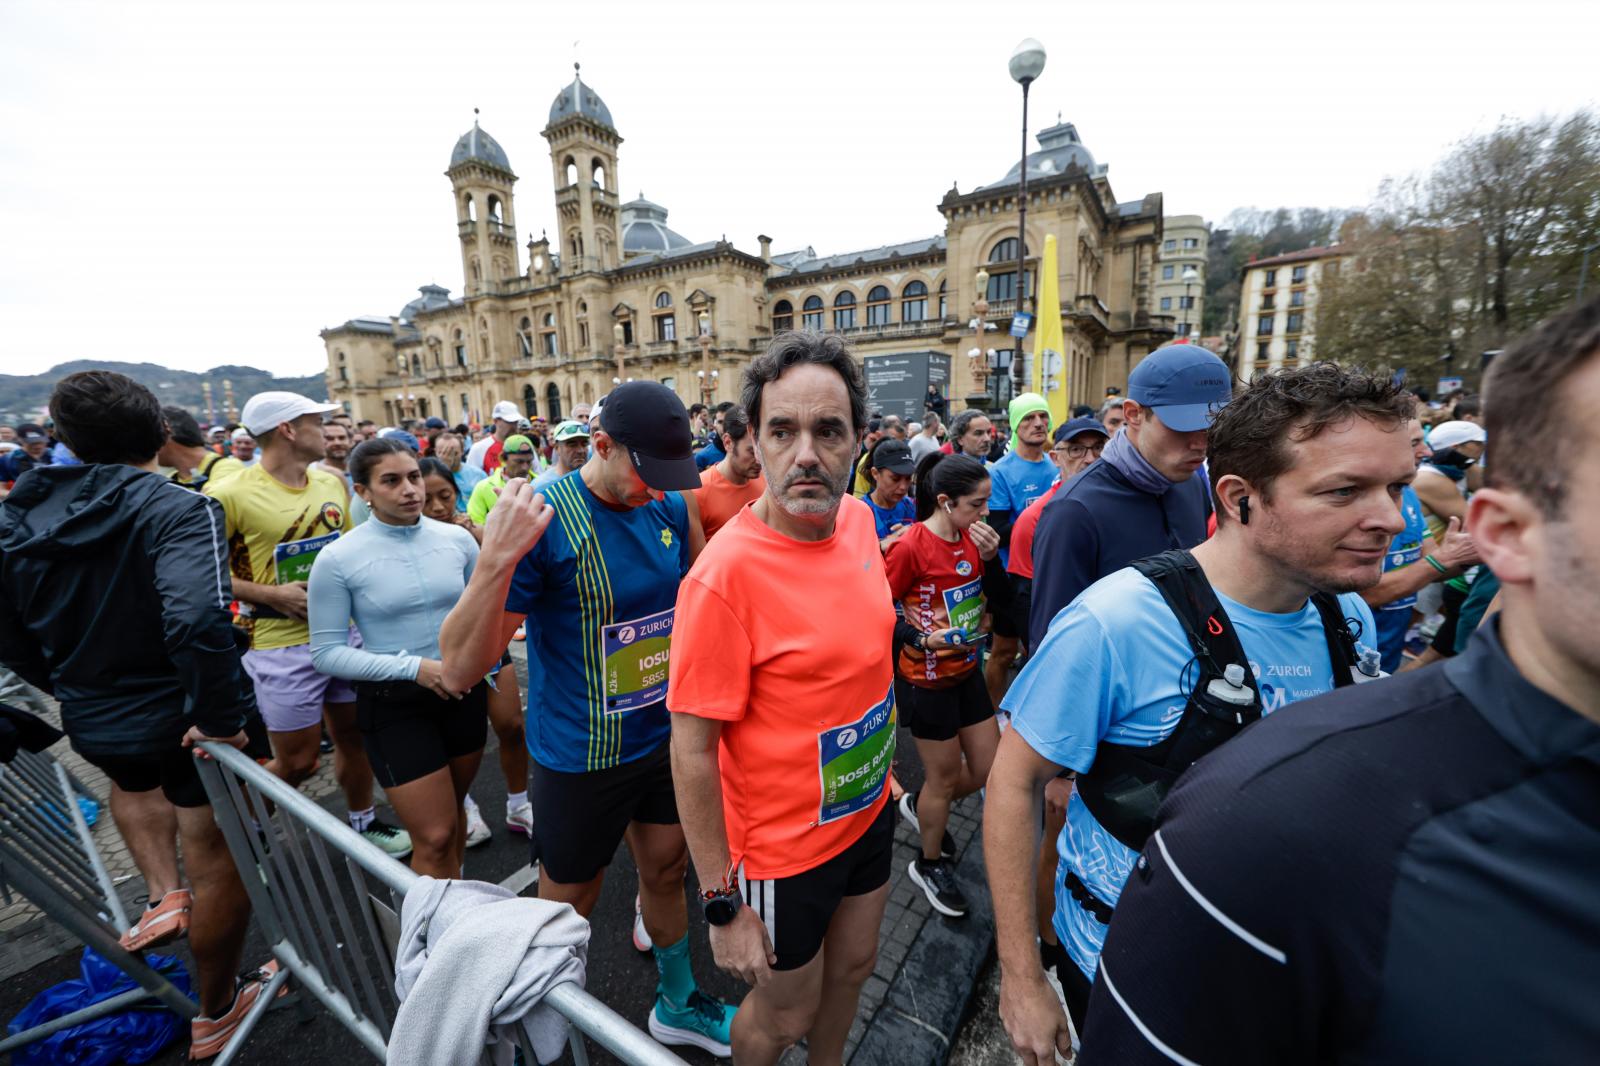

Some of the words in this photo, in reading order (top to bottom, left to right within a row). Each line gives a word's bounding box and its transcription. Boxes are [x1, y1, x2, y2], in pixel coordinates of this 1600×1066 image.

[640, 617, 673, 636] ZURICH
[640, 649, 670, 671] IOSU
[1267, 665, 1312, 676] ZURICH
[642, 669, 665, 687] 5855
[862, 699, 891, 736] ZURICH
[837, 762, 871, 788] JOSE
[862, 762, 887, 790] 4676
